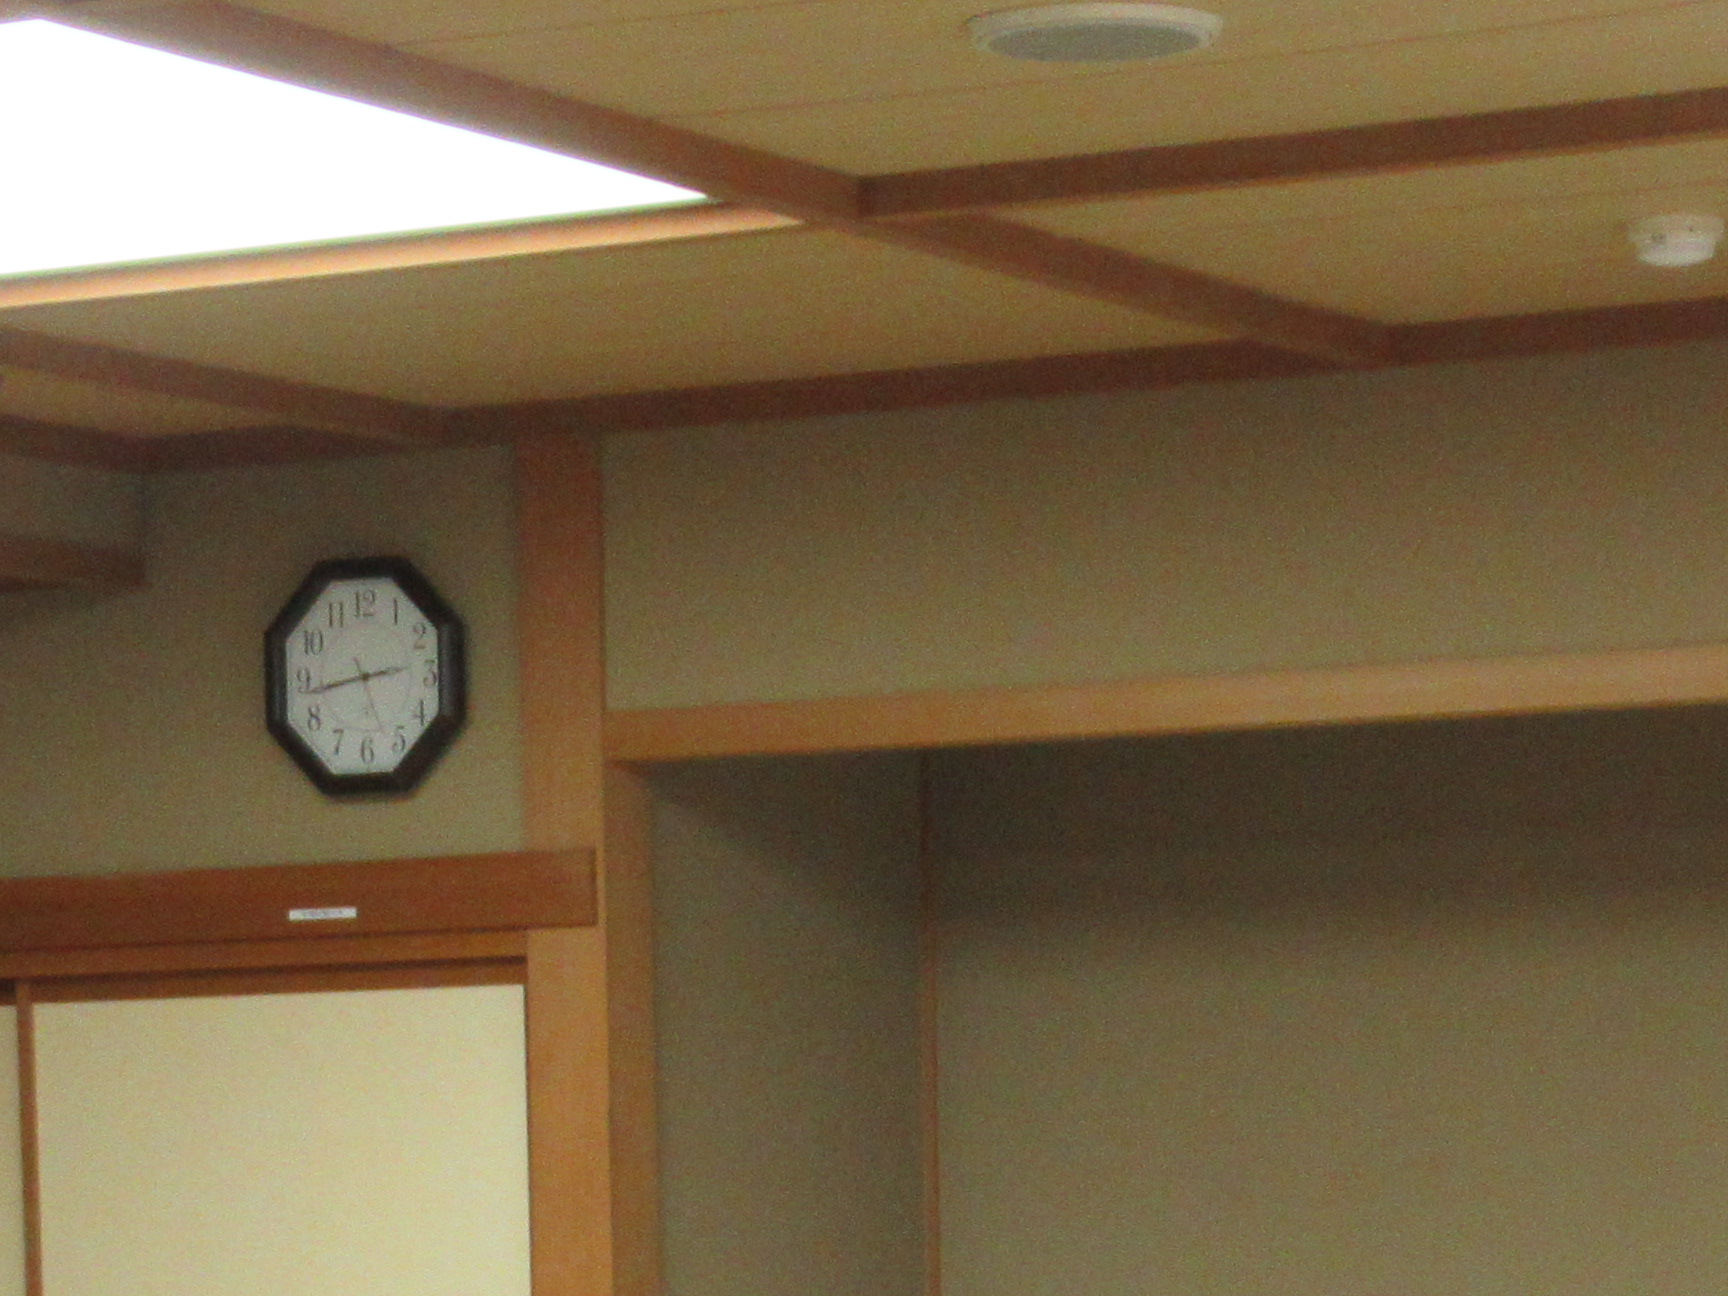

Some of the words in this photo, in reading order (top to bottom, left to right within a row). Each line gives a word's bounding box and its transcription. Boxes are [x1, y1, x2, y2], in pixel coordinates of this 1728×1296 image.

[328, 603, 344, 627] 11
[354, 590, 376, 618] 12
[392, 598, 399, 625] 1
[303, 630, 323, 655] 10
[413, 623, 427, 650] 2
[297, 668, 310, 693] 9
[424, 660, 437, 686] 3
[308, 706, 321, 730] 8
[412, 700, 426, 726] 4
[333, 729, 344, 755] 7
[361, 736, 373, 763] 6
[393, 727, 406, 753] 5
